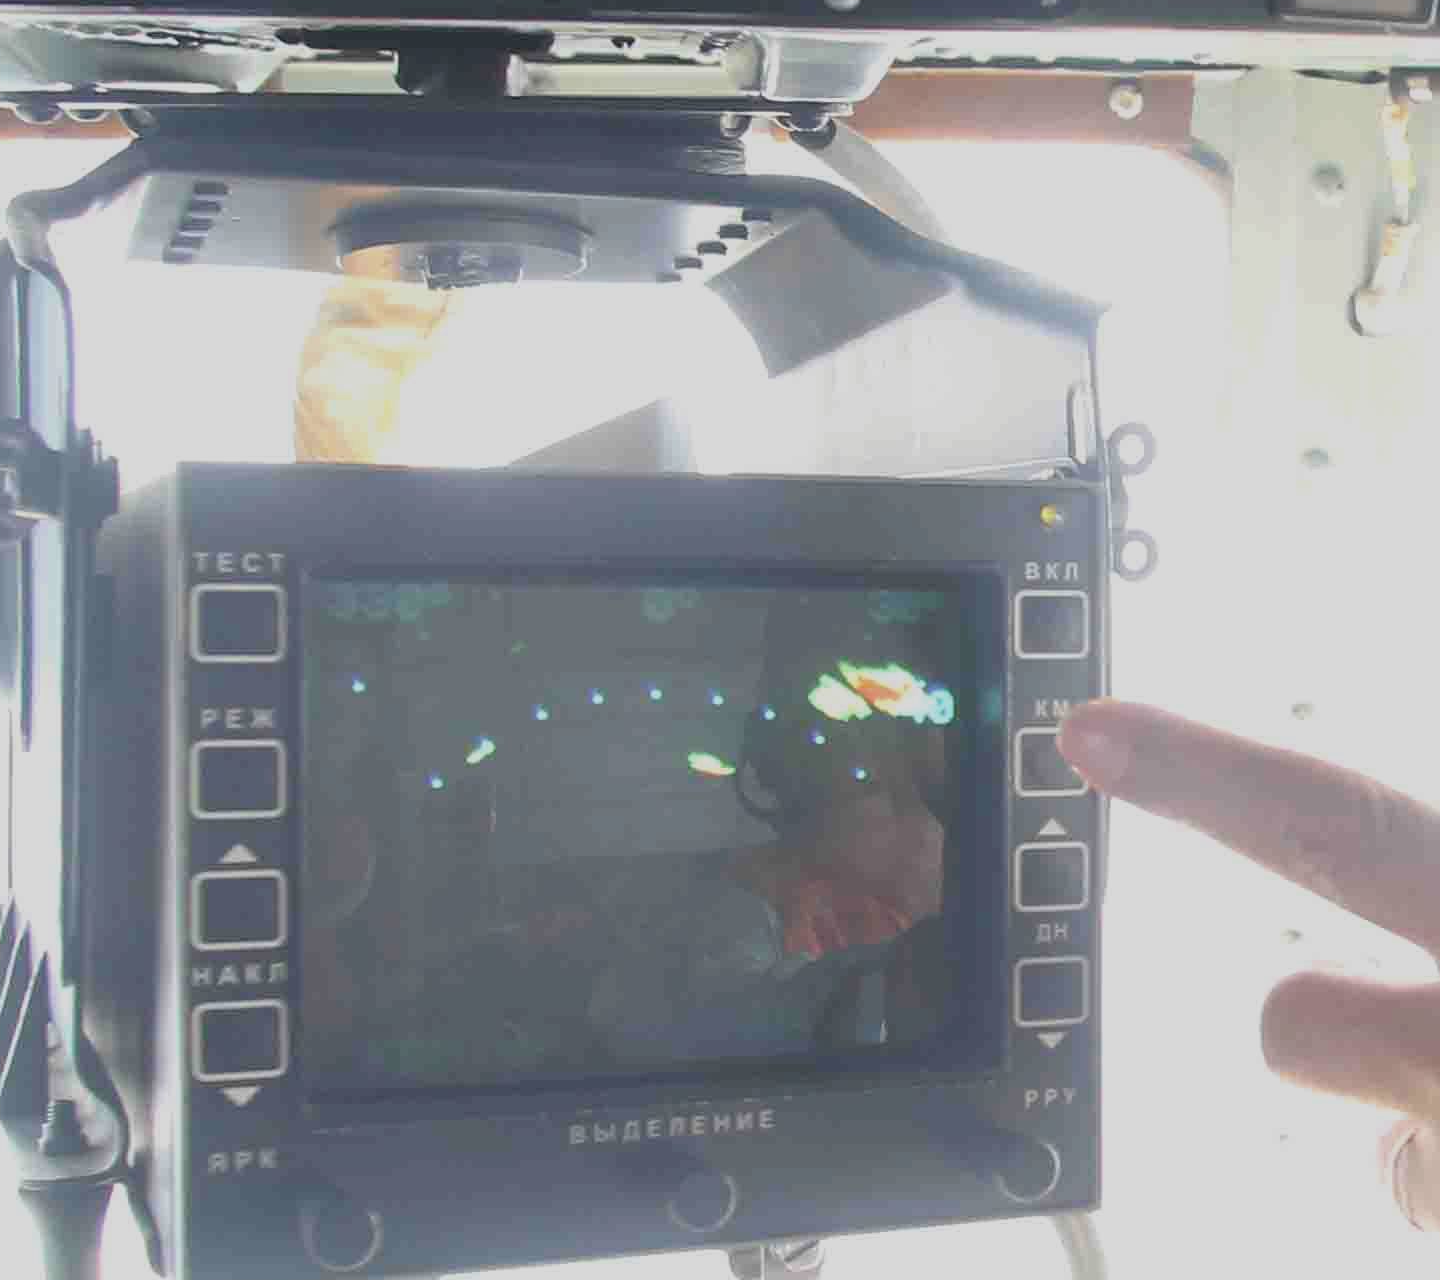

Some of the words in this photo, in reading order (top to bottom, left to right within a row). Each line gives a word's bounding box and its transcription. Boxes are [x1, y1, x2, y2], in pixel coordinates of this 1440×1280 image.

[192, 552, 286, 573] ТЕСТ
[1024, 561, 1080, 581] ВКЛ
[200, 708, 276, 729] РЕЖ
[1034, 924, 1070, 943] ДН
[191, 961, 288, 986] НАКЛ
[1024, 1087, 1078, 1109] РРУ
[568, 1108, 777, 1145] ВЫДЕЛЕНИЕ
[207, 1150, 279, 1174] ЯРК
